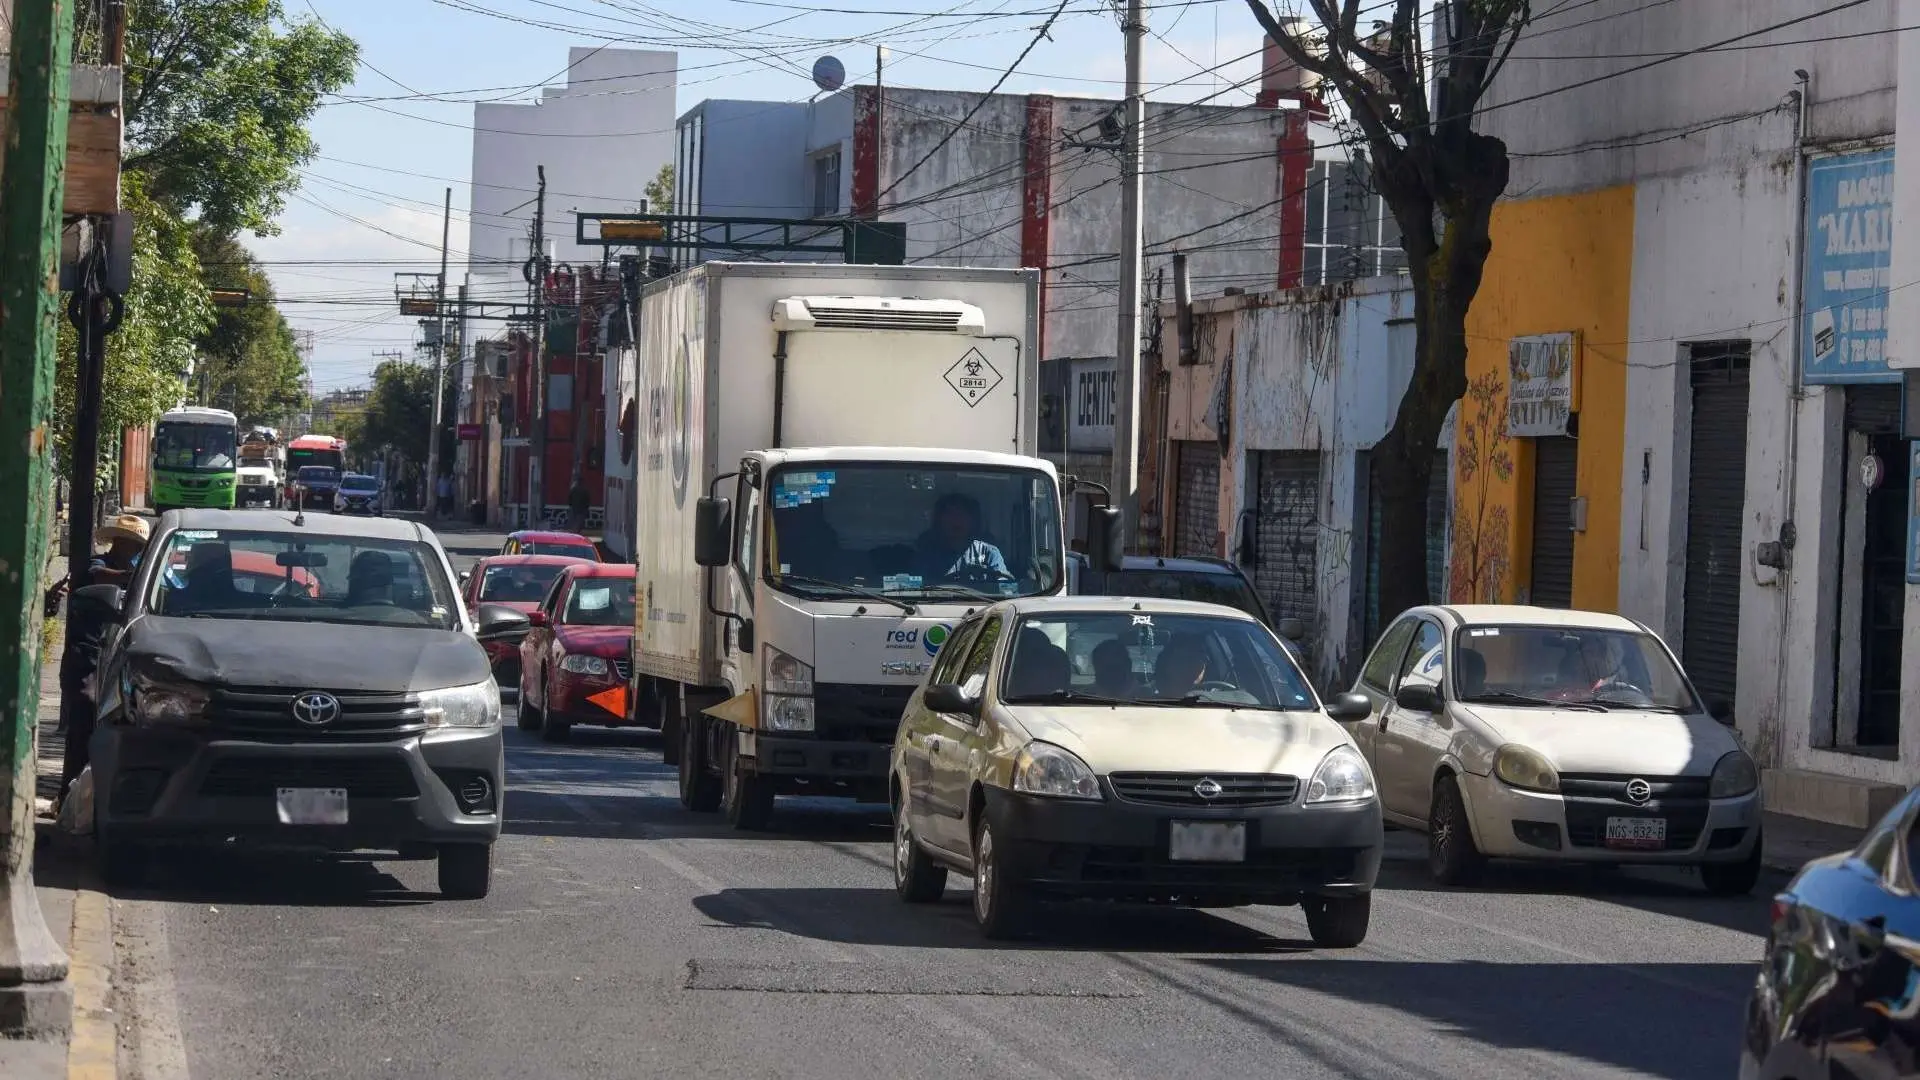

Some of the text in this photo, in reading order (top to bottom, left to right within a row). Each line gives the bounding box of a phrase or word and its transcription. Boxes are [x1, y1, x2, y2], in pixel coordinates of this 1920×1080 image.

[1818, 209, 1892, 254] "MARI
[970, 389, 976, 398] 6
[886, 627, 918, 642] red
